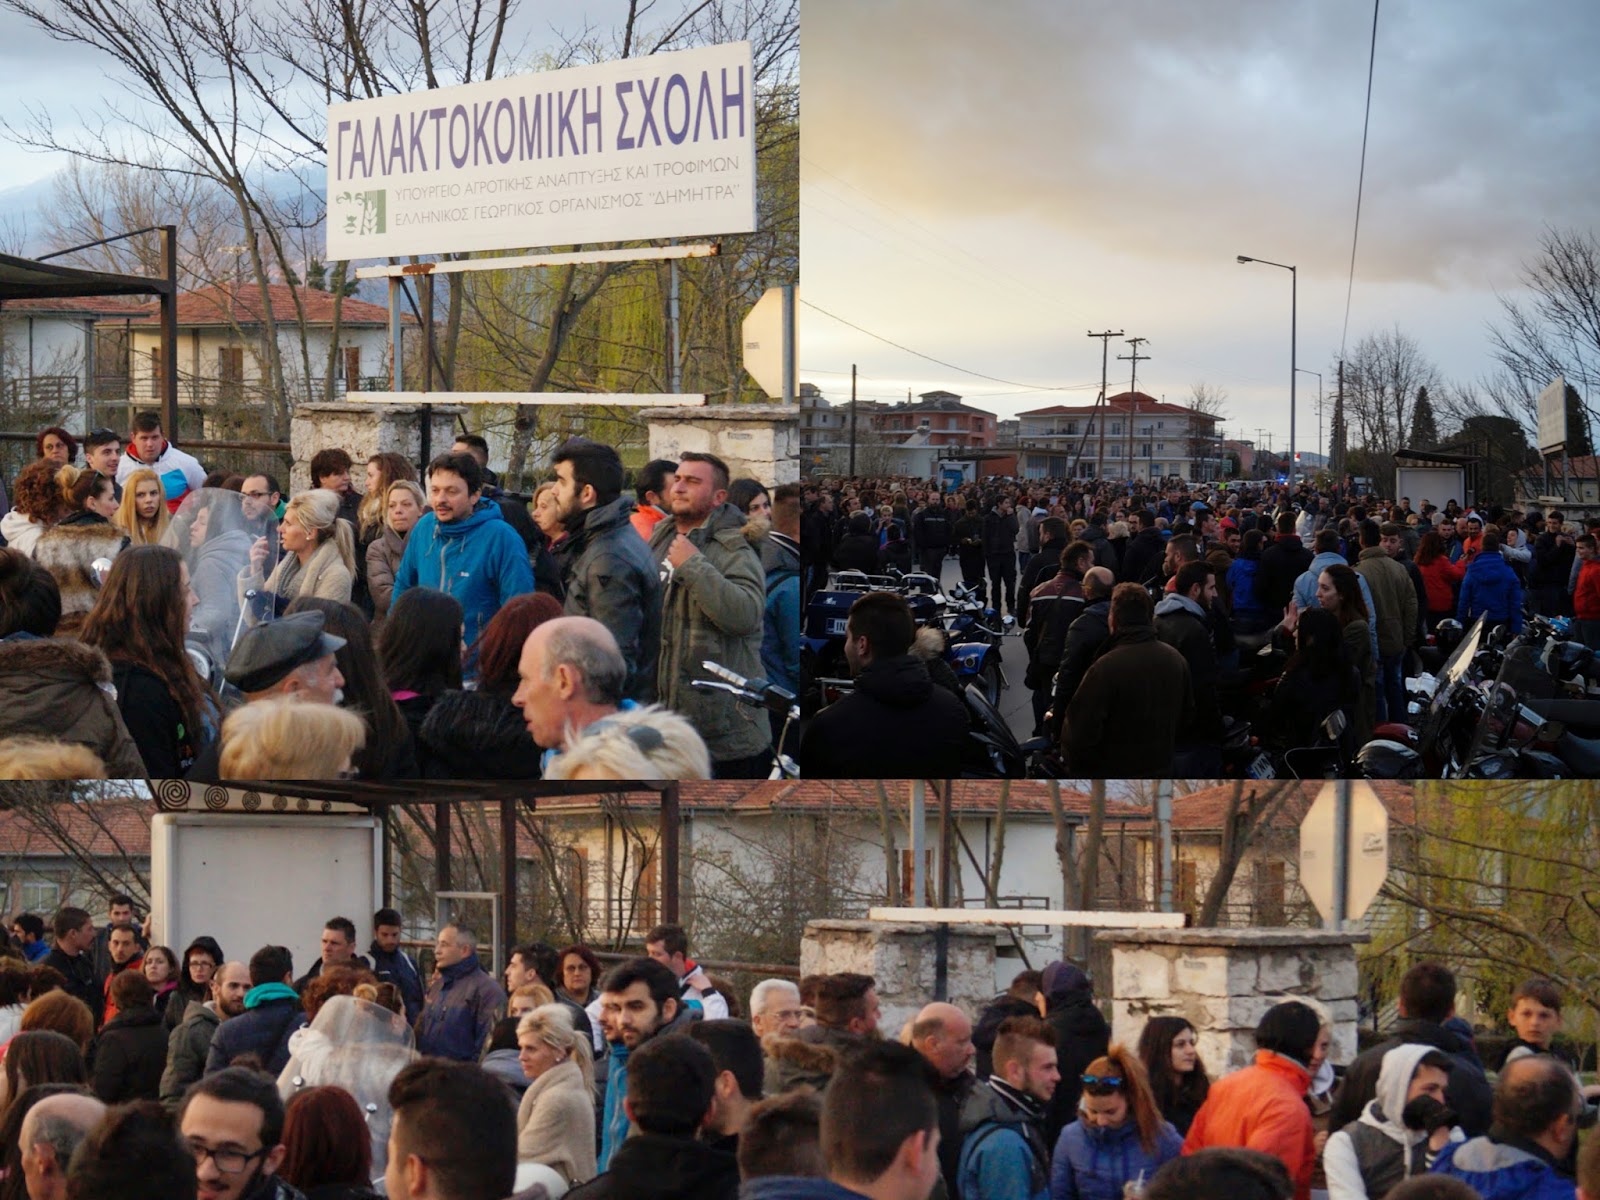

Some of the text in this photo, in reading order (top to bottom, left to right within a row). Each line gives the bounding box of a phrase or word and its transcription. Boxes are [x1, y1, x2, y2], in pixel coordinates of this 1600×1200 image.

[337, 65, 745, 181] ΓΑΛΑΚΤΟΚΟΜΙΚΗ ΣΧΟΛΗ
[395, 156, 739, 201] ΥΠΟΥΡΓΕΙΟ ΑΓΡΟΤΙΚΗΣ ΑΝΑΠΤΥΞΗΣ ΚΑΙ ΤΡΟΦΙΜΩΝ
[395, 207, 469, 226] ΕΛΛΗΝΙΚΟΣ
[474, 201, 544, 221] ΓΕΩΡΓΙΚΟΣ
[549, 192, 643, 213] ΟΡΓΑΝΙΣΜΟΣ
